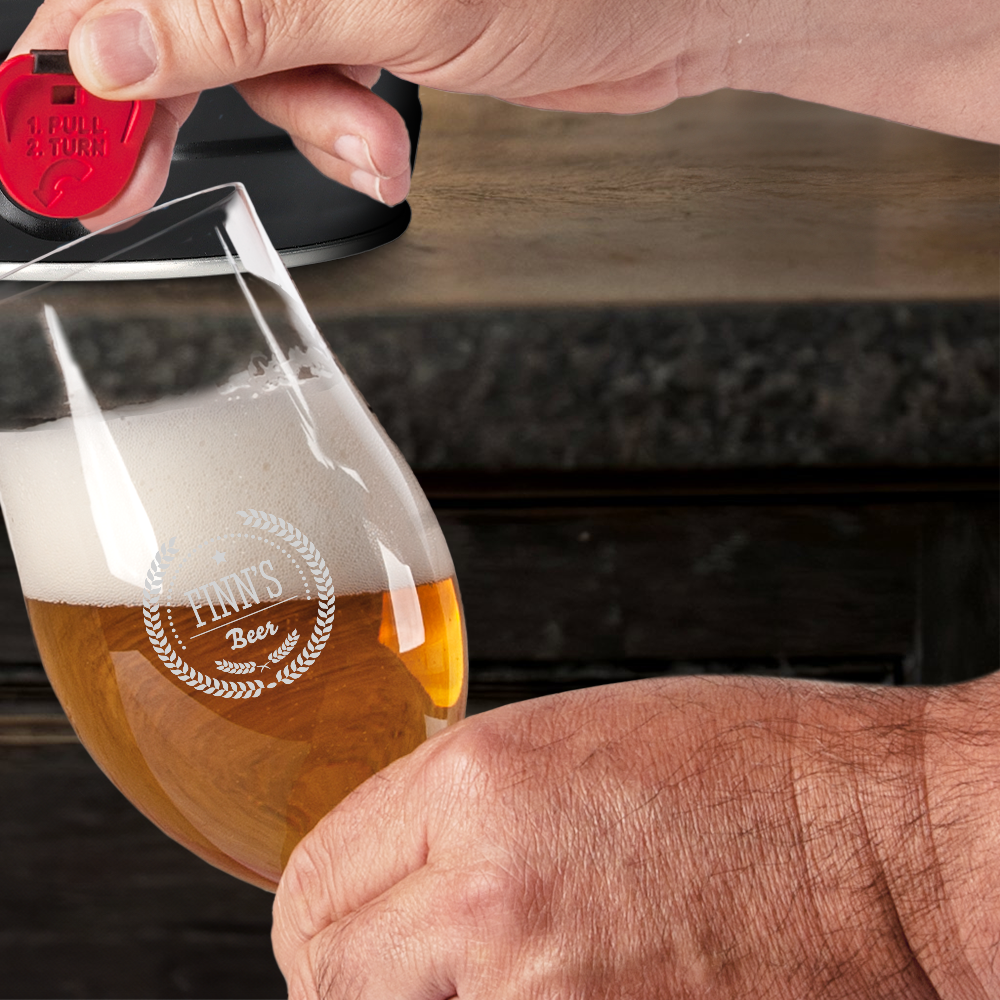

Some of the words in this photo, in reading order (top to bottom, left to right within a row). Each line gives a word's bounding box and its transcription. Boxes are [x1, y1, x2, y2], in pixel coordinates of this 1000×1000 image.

[26, 137, 44, 157] 2.
[48, 137, 108, 157] TURN
[183, 559, 283, 629] FINN'S
[225, 620, 279, 651] Beer
